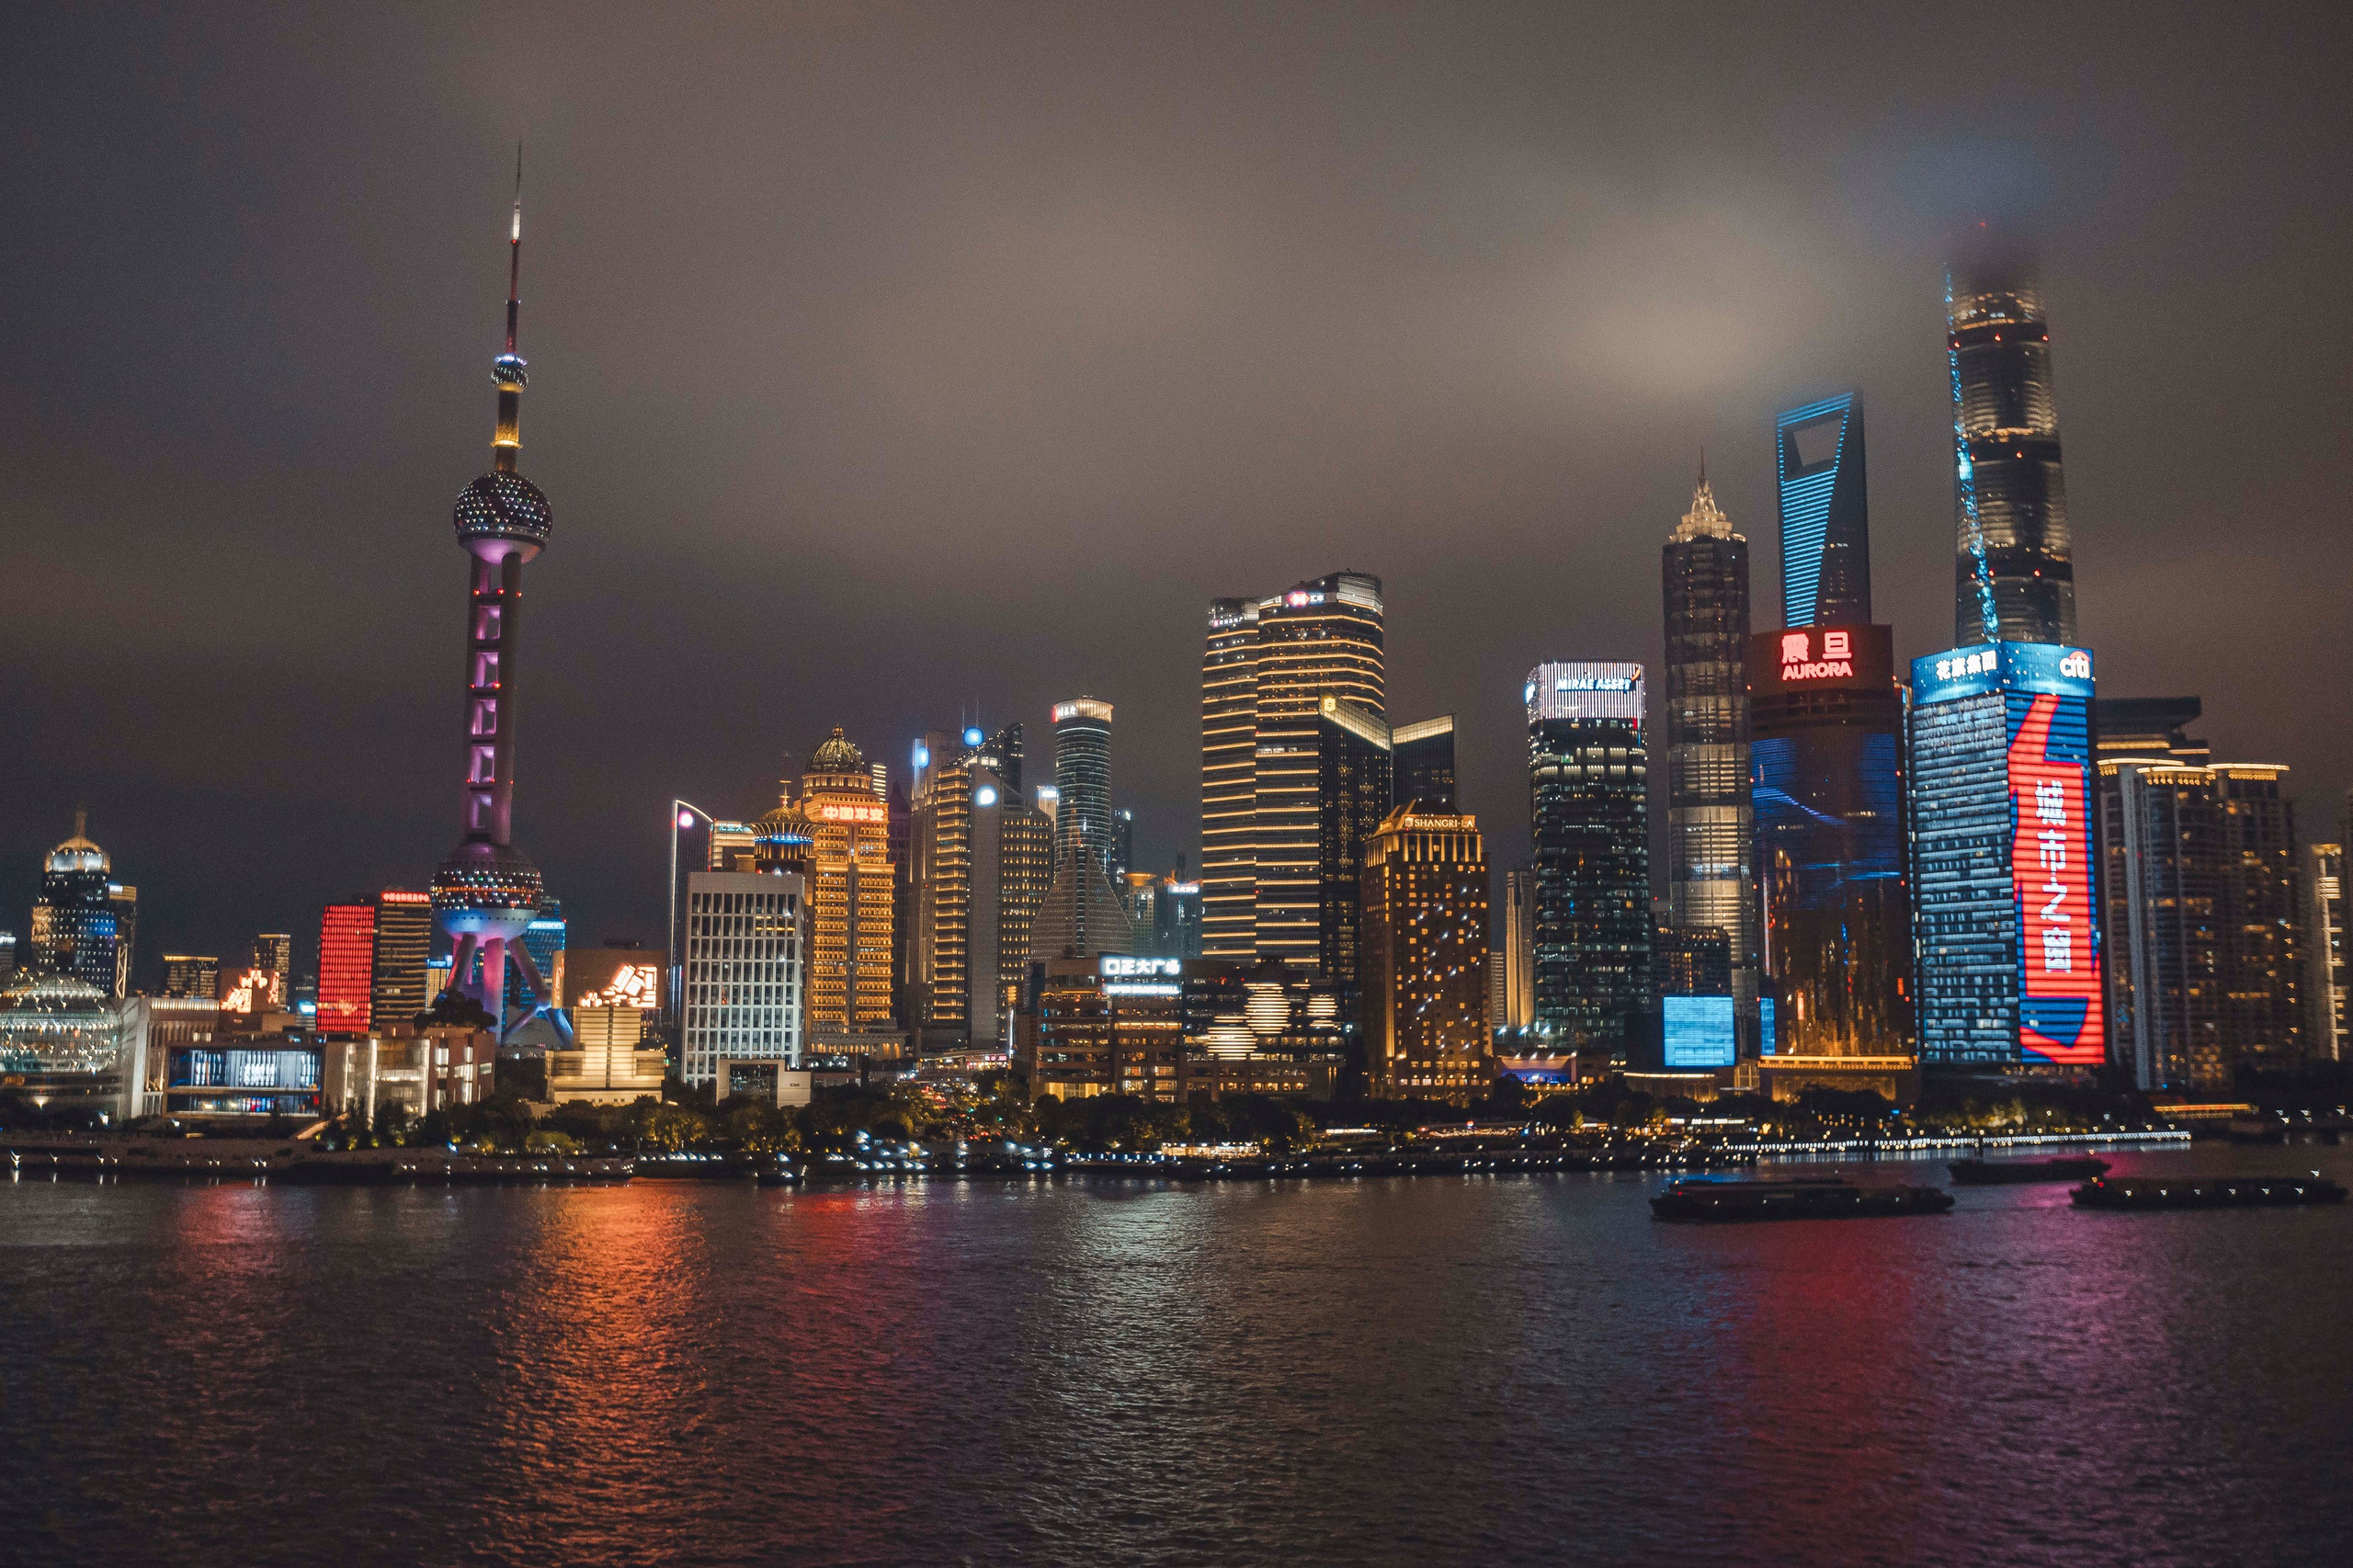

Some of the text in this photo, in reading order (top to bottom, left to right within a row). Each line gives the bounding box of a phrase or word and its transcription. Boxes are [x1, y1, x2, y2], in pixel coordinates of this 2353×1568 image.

[1781, 631, 1853, 664] 震旦
[1781, 661, 1854, 680] AURORA
[1936, 650, 1997, 680] 花旗集团
[2059, 653, 2091, 678] citi
[1556, 678, 1631, 690] MIRAE ASSET
[824, 806, 884, 822] 中国平安
[1415, 818, 1474, 828] SHANGRI-LA
[1120, 959, 1180, 974] 正大广场
